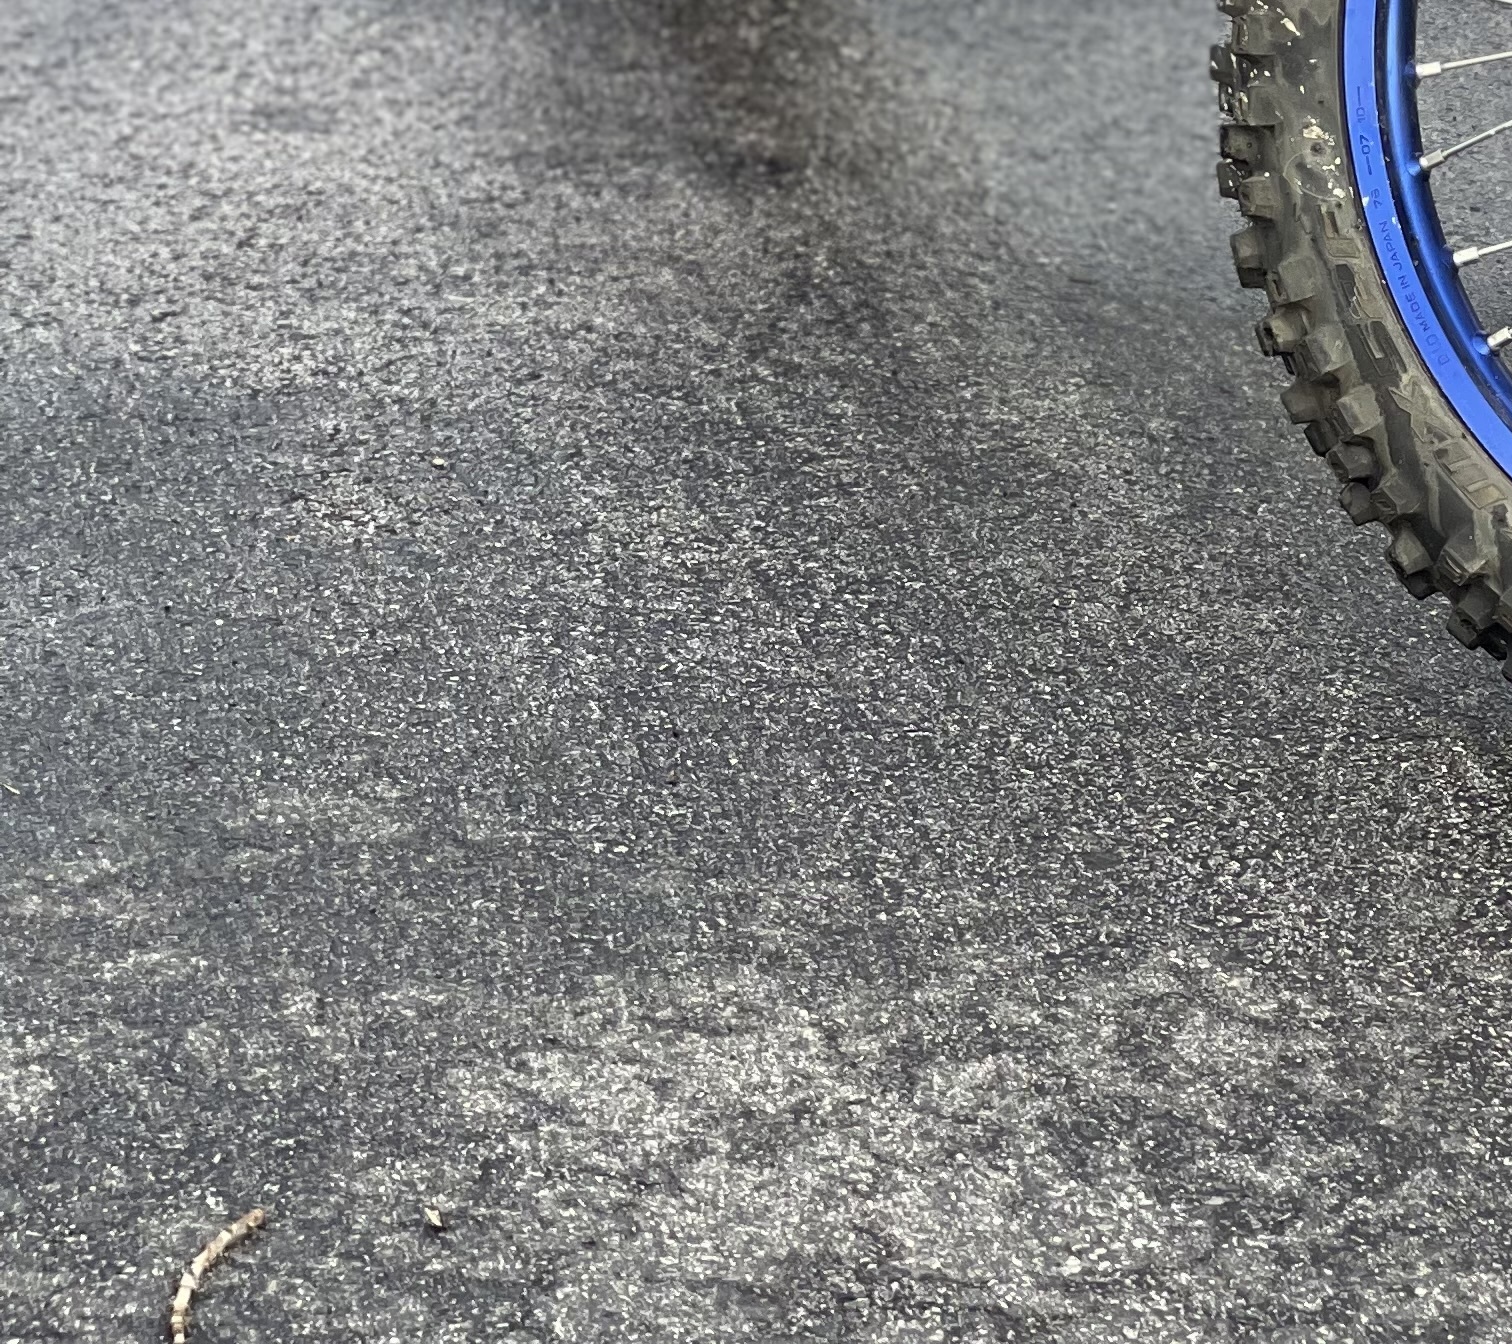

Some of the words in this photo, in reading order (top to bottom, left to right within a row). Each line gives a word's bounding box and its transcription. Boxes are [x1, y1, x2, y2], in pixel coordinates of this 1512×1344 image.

[1378, 220, 1403, 272] JAPAN
[1398, 275, 1411, 290] IN
[1405, 292, 1431, 333] MADE
